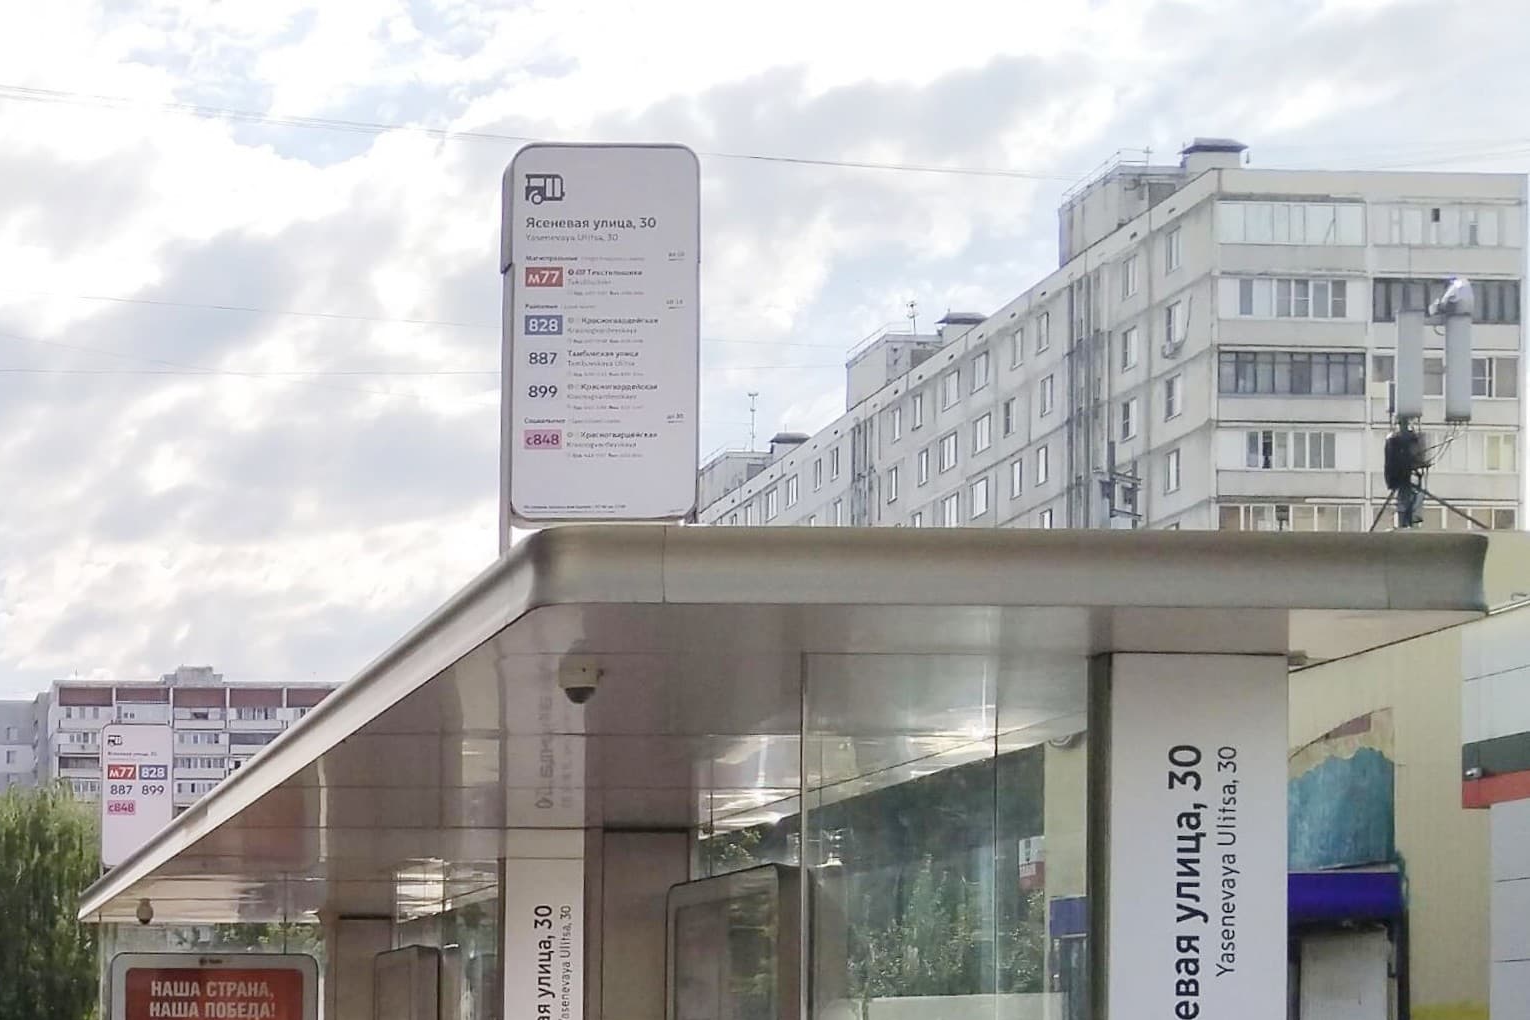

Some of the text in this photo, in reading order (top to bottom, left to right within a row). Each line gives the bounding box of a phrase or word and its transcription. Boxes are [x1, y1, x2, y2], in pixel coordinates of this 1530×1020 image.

[526, 217, 657, 231] Ясеневая улица, 30
[528, 318, 559, 332] 828
[528, 352, 558, 365] 887
[528, 385, 558, 398] 899
[526, 434, 560, 446] с848
[141, 767, 166, 778] 828
[1167, 743, 1202, 792] 30
[110, 785, 165, 795] 887 899
[108, 802, 135, 813] с848
[1175, 801, 1209, 923] улица,
[1216, 746, 1241, 976] Yasenevaya Ulitsa, 30
[534, 905, 553, 930] 30
[560, 905, 572, 921] 30
[560, 922, 573, 958] Ulitsa,
[537, 935, 556, 999] улица,
[150, 980, 275, 1000] НАША СТРАНА,
[149, 1001, 276, 1020] НАША ПОБЕДА!
